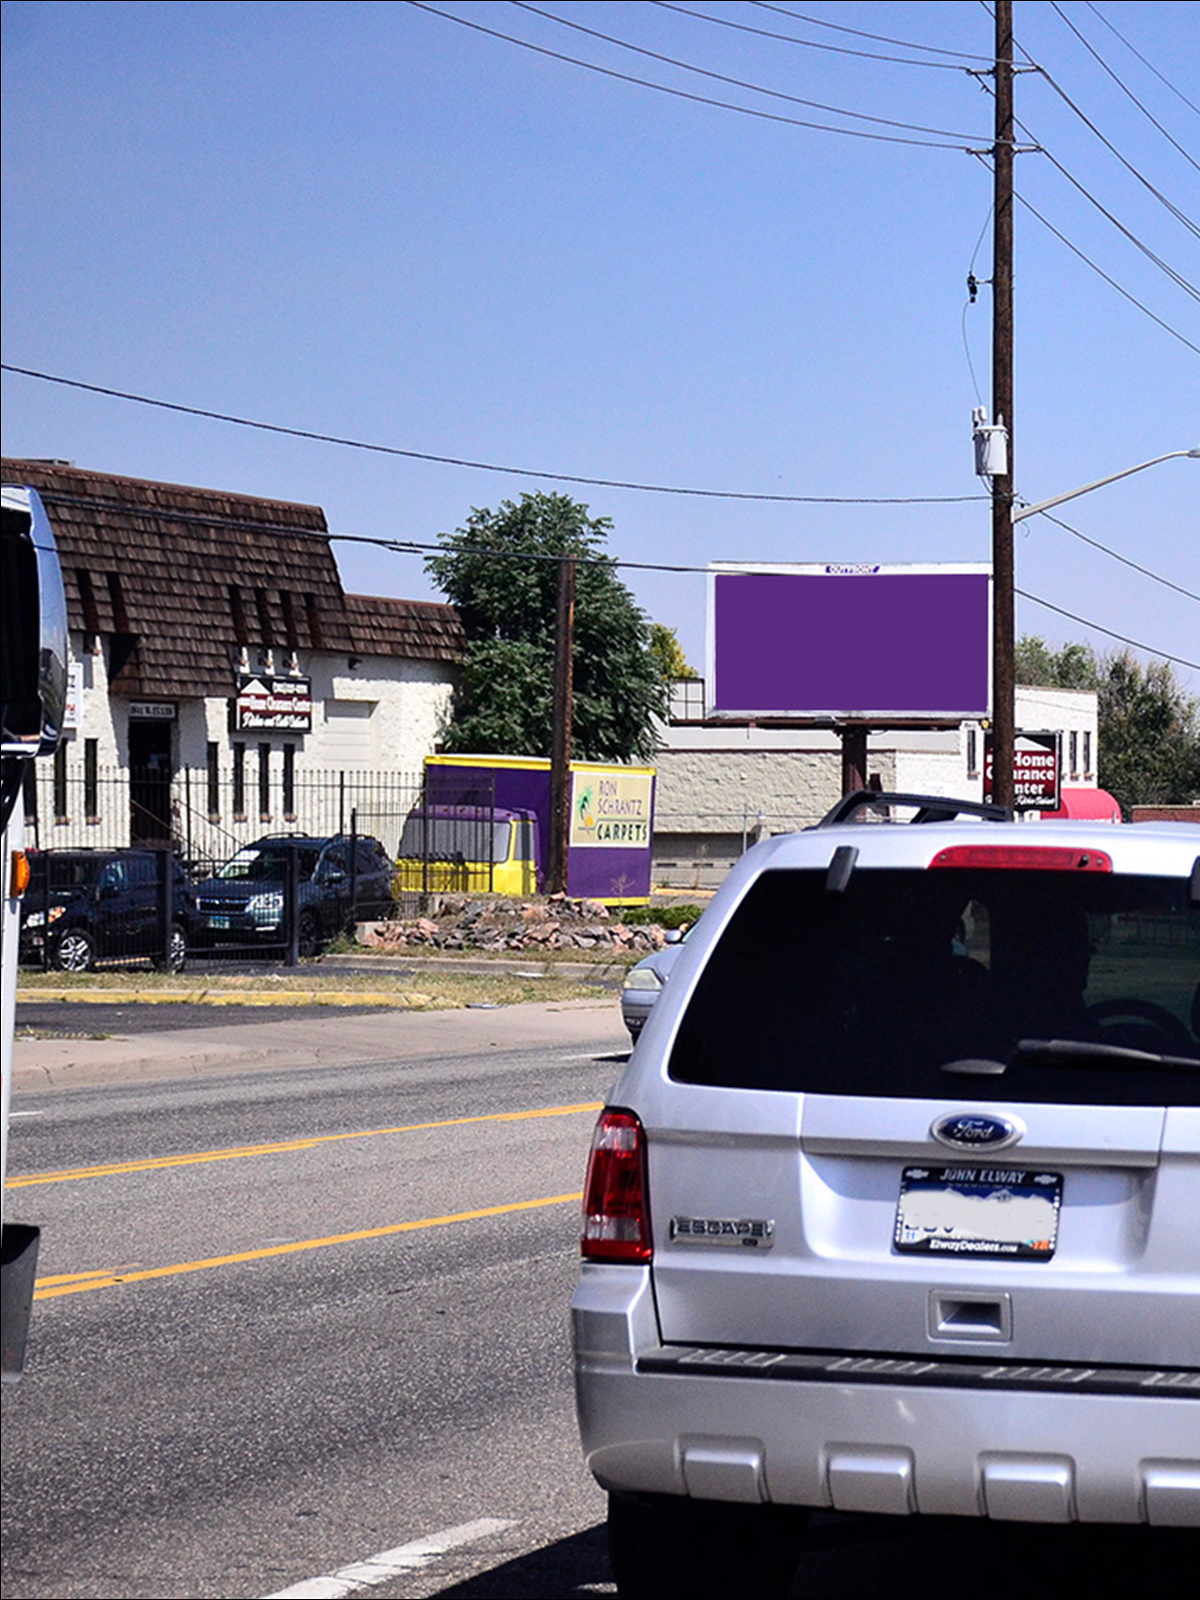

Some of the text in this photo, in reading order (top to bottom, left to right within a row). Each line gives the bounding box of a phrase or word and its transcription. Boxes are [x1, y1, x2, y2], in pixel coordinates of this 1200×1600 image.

[599, 780, 617, 797] RON
[597, 798, 642, 815] SCHRANTZ
[597, 823, 647, 841] CARPETS
[953, 1121, 994, 1139] Ford
[940, 1168, 1026, 1184] JOHN ELWAY
[678, 1220, 764, 1237] ESCAPE
